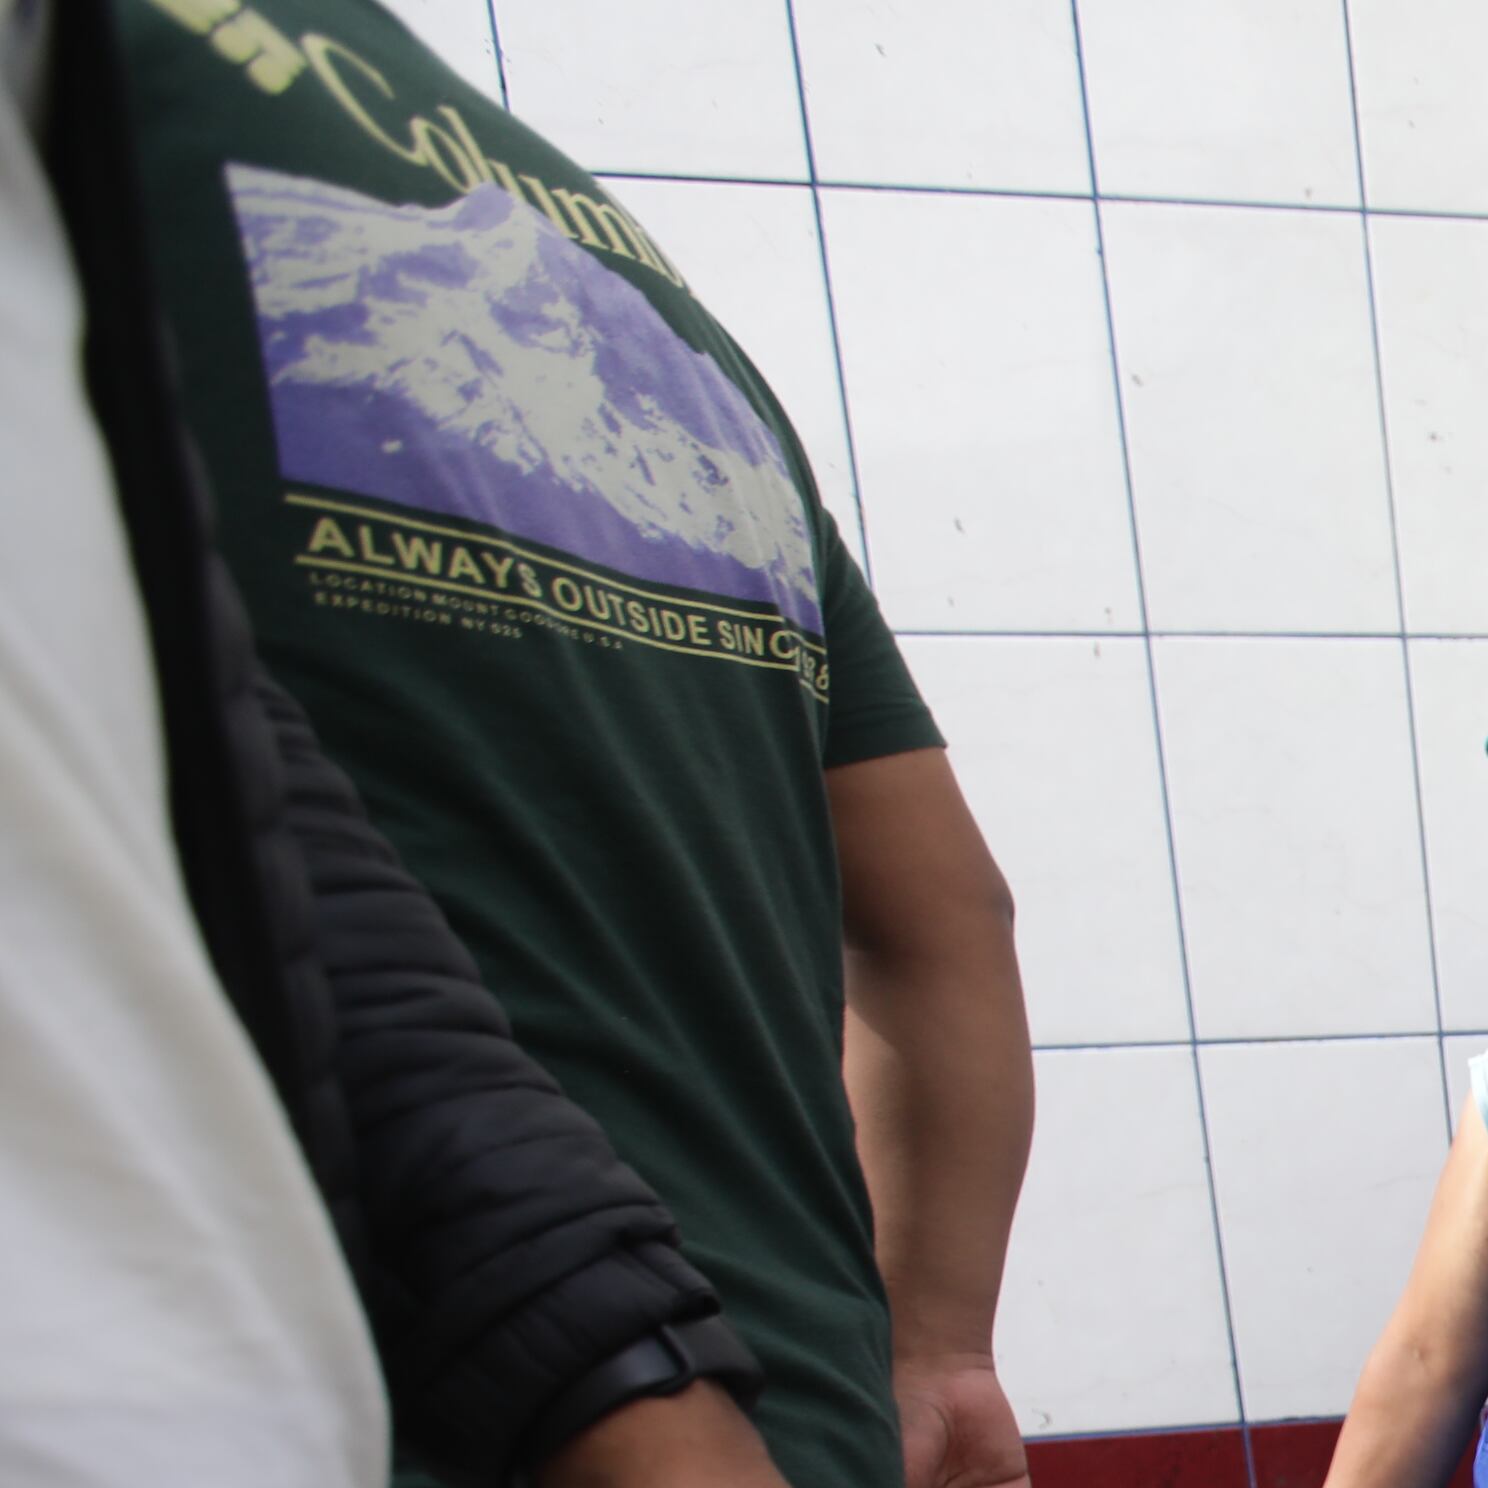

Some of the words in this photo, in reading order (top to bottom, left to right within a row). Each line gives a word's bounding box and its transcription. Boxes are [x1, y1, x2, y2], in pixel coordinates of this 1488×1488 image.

[308, 571, 428, 603] LOCATION
[308, 516, 542, 598] ALWAYS
[552, 576, 712, 646] OUTSIDE
[717, 620, 800, 664] SINC
[313, 590, 453, 626] EXPEDITION
